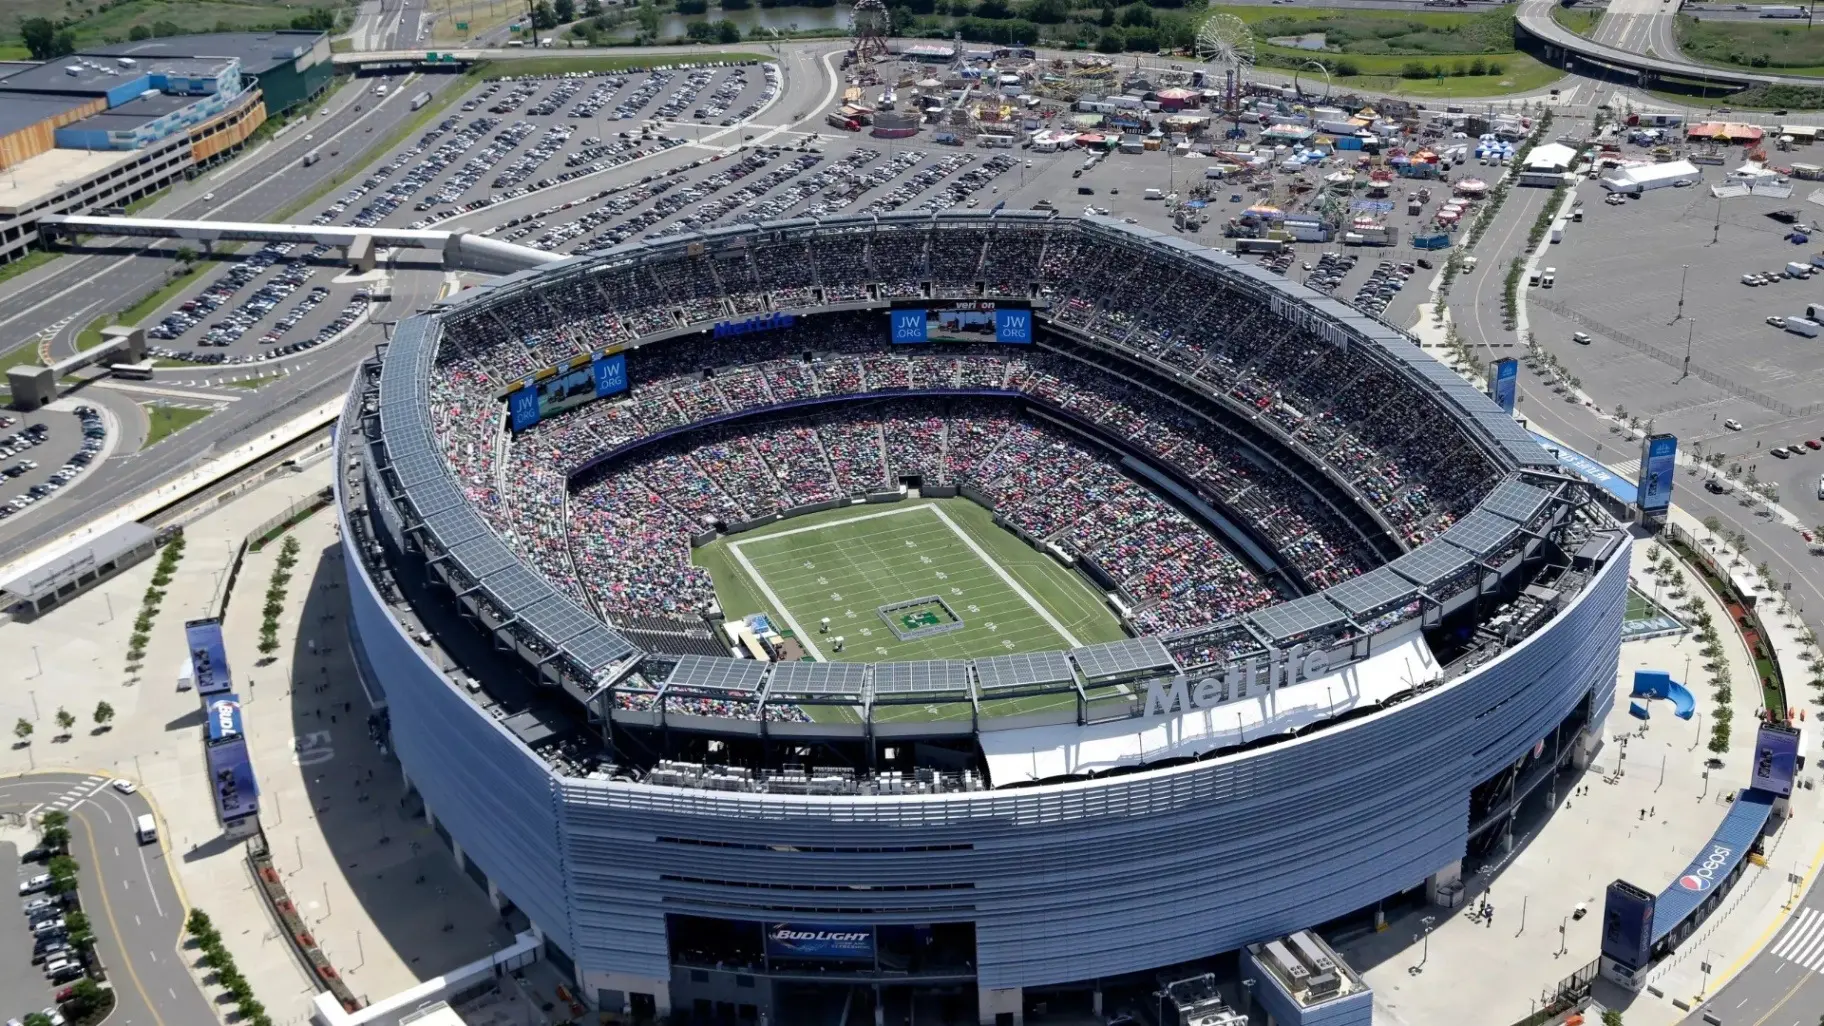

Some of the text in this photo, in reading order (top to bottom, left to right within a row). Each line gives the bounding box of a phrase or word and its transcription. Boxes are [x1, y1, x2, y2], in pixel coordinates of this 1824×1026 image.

[956, 301, 995, 309] verion
[898, 316, 920, 328] JW
[1002, 315, 1025, 328] JW
[600, 362, 620, 380] JW
[516, 394, 533, 413] JW
[1143, 643, 1330, 718] MetLife
[218, 704, 234, 729] BUD
[1696, 844, 1732, 880] pepsi
[776, 930, 870, 941] BUD LIGHT
